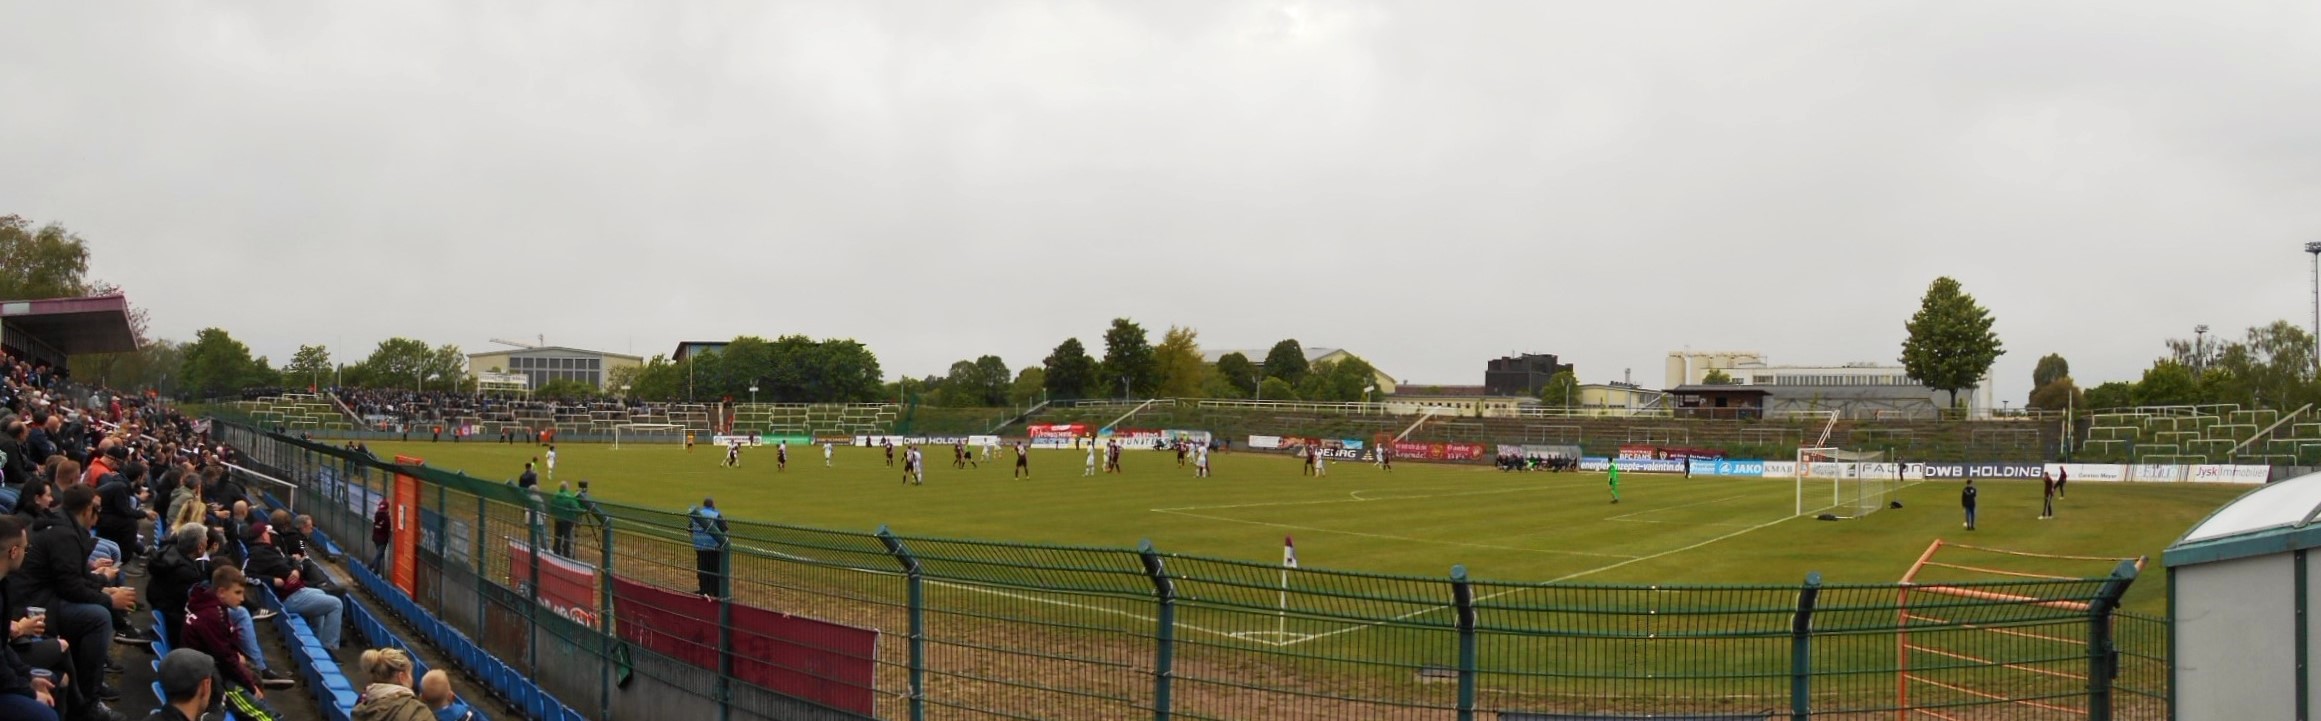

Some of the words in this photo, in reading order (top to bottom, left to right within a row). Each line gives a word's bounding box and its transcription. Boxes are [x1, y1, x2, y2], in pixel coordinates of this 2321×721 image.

[904, 437, 926, 445] DWB
[1581, 460, 1685, 472] energieknzepte-valentin.de
[1733, 464, 1762, 474] JAKO
[1764, 465, 1793, 474] KMAB
[1925, 466, 1963, 477] DWB
[1969, 466, 2042, 477] HOLDING
[2196, 466, 2218, 478] Jysk
